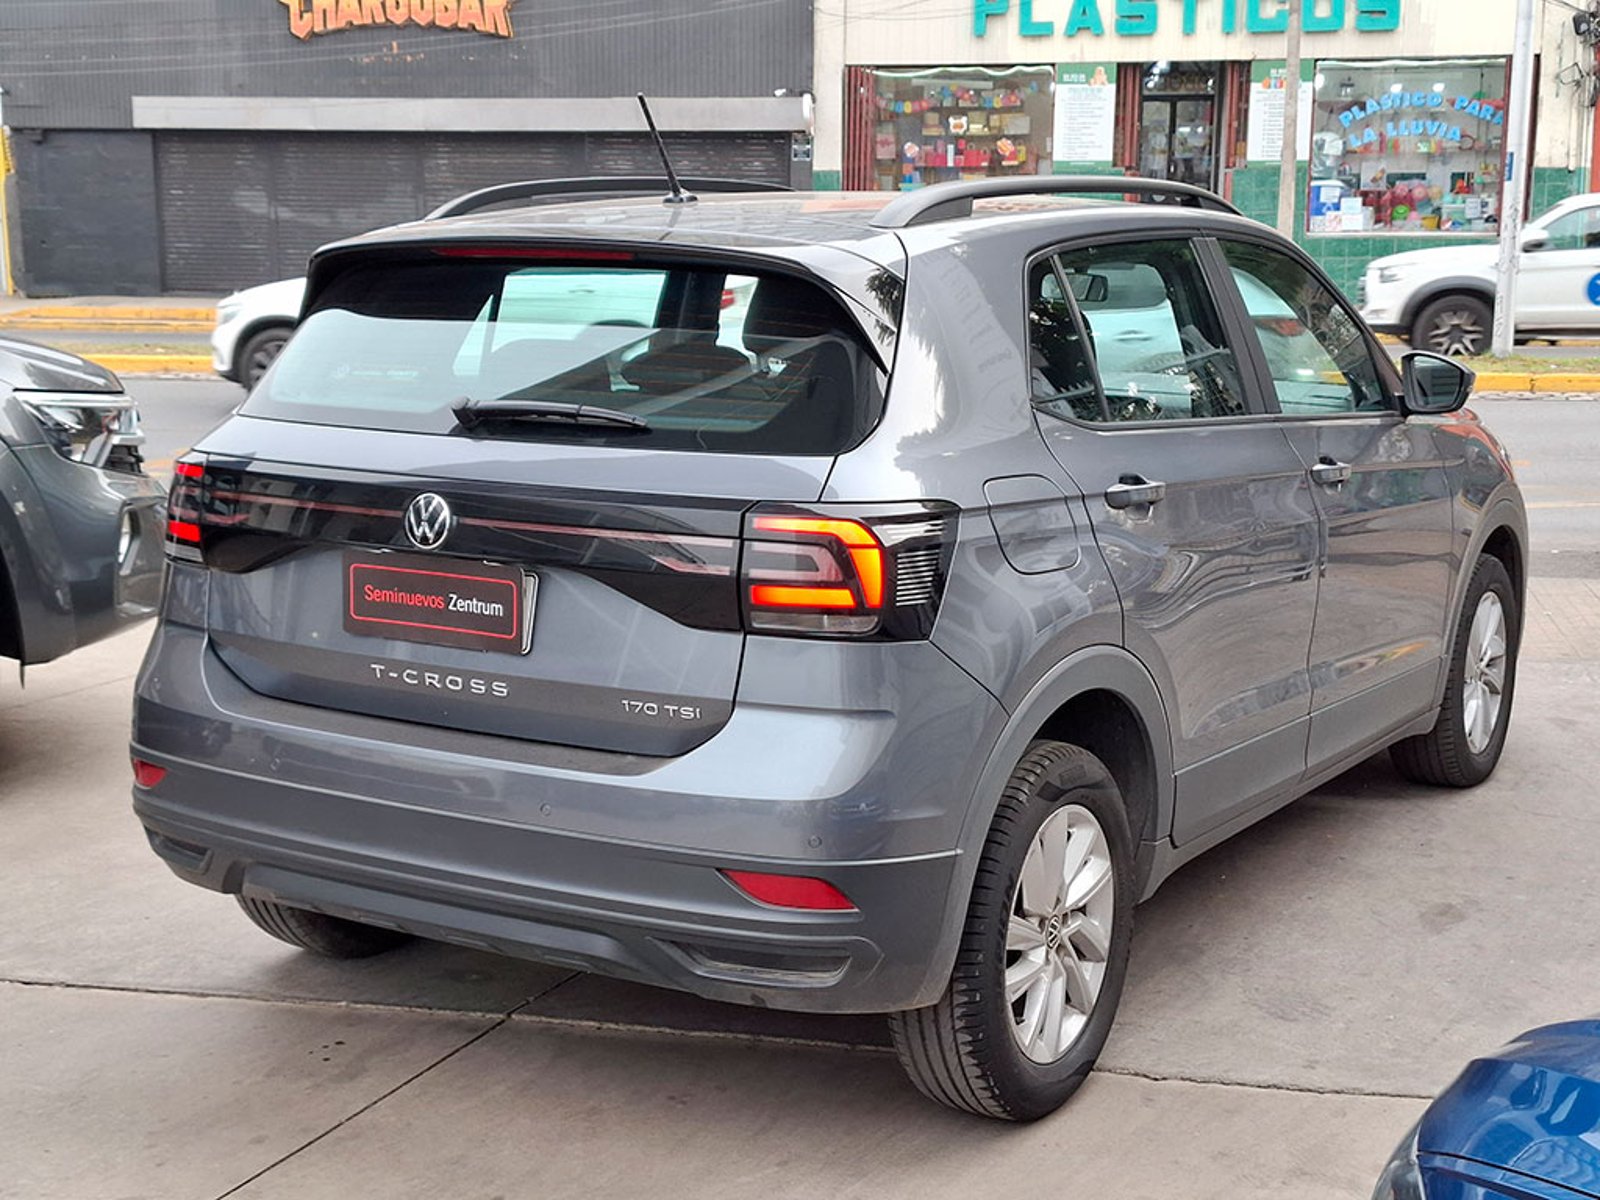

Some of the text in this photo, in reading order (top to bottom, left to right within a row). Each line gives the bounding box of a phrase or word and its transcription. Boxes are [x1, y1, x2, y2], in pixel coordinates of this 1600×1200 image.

[974, 0, 1399, 36] PLASTICOS
[1339, 93, 1442, 127] PLASTICO
[1349, 120, 1462, 148] LA LLUVIA
[363, 584, 504, 617] Seminuevos Zentrum
[370, 663, 509, 698] T-CROSS
[621, 699, 702, 720] 170 TSI
